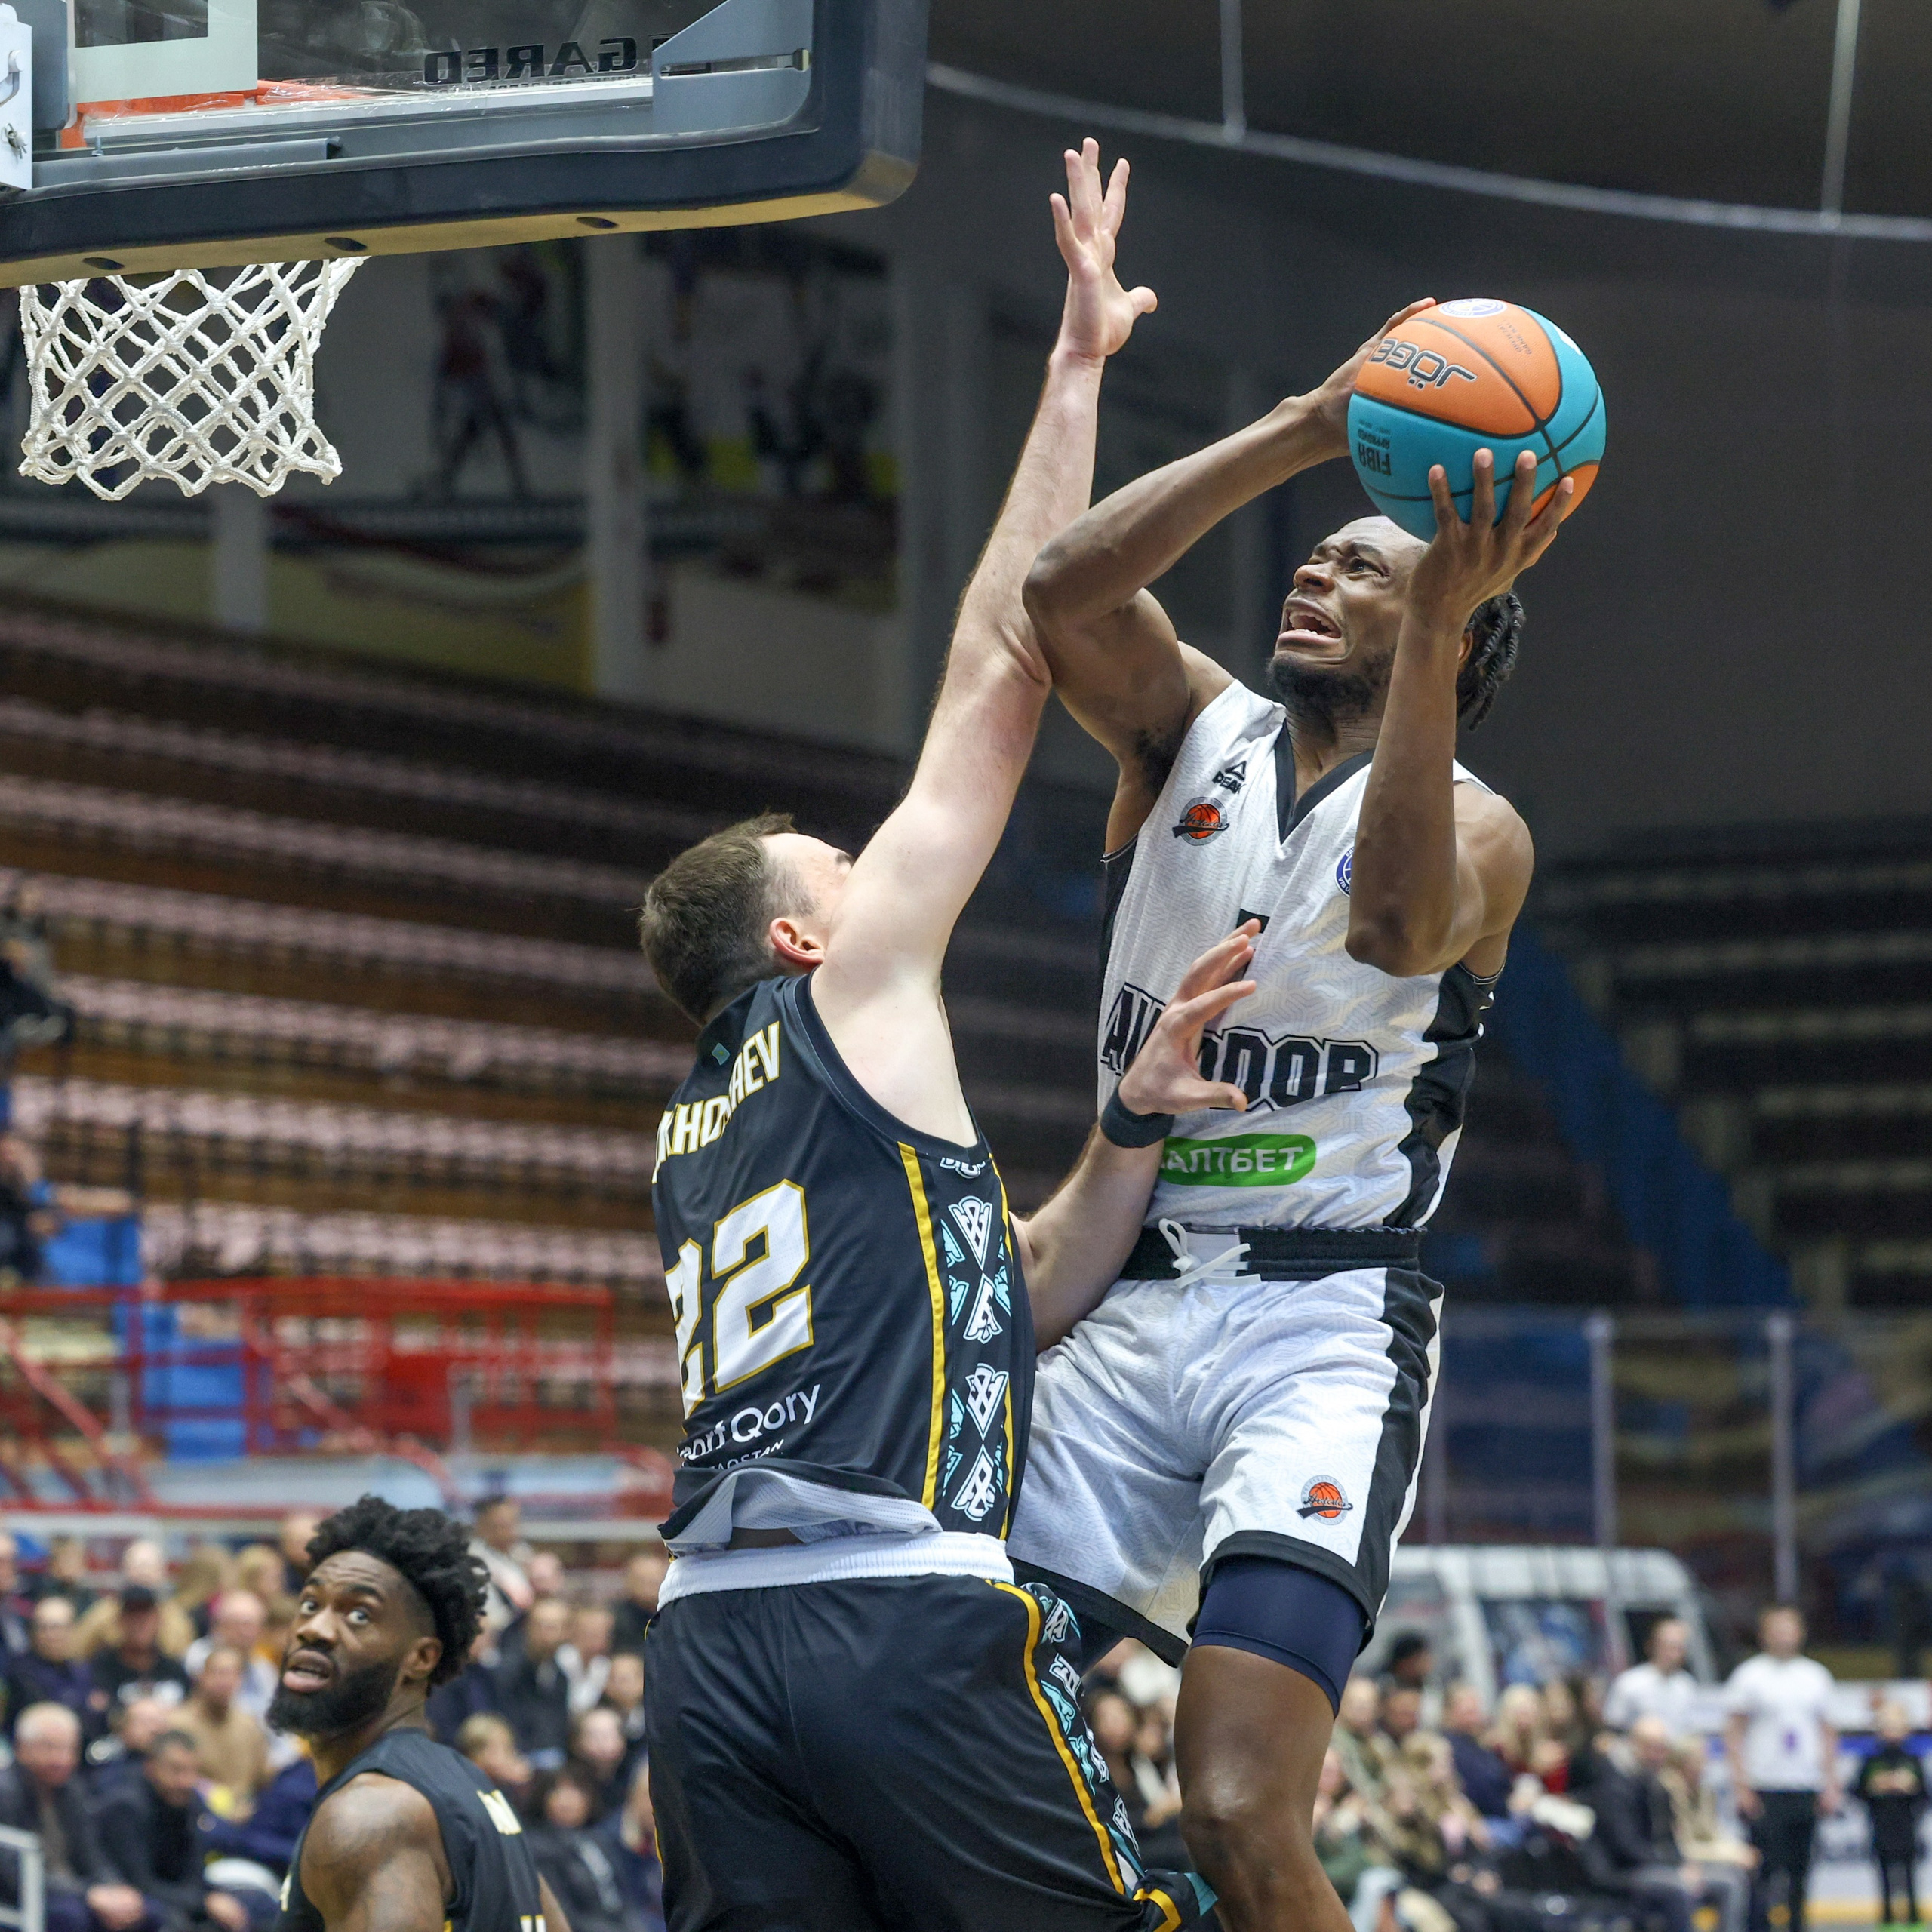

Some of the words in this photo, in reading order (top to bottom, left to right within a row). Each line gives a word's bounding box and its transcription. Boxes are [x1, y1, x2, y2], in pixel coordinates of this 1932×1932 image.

[1369, 337, 1478, 390] JÖGE
[1212, 771, 1247, 795] PEAK
[1160, 1146, 1304, 1174] АЛТБЕТ
[665, 1179, 814, 1420] 22
